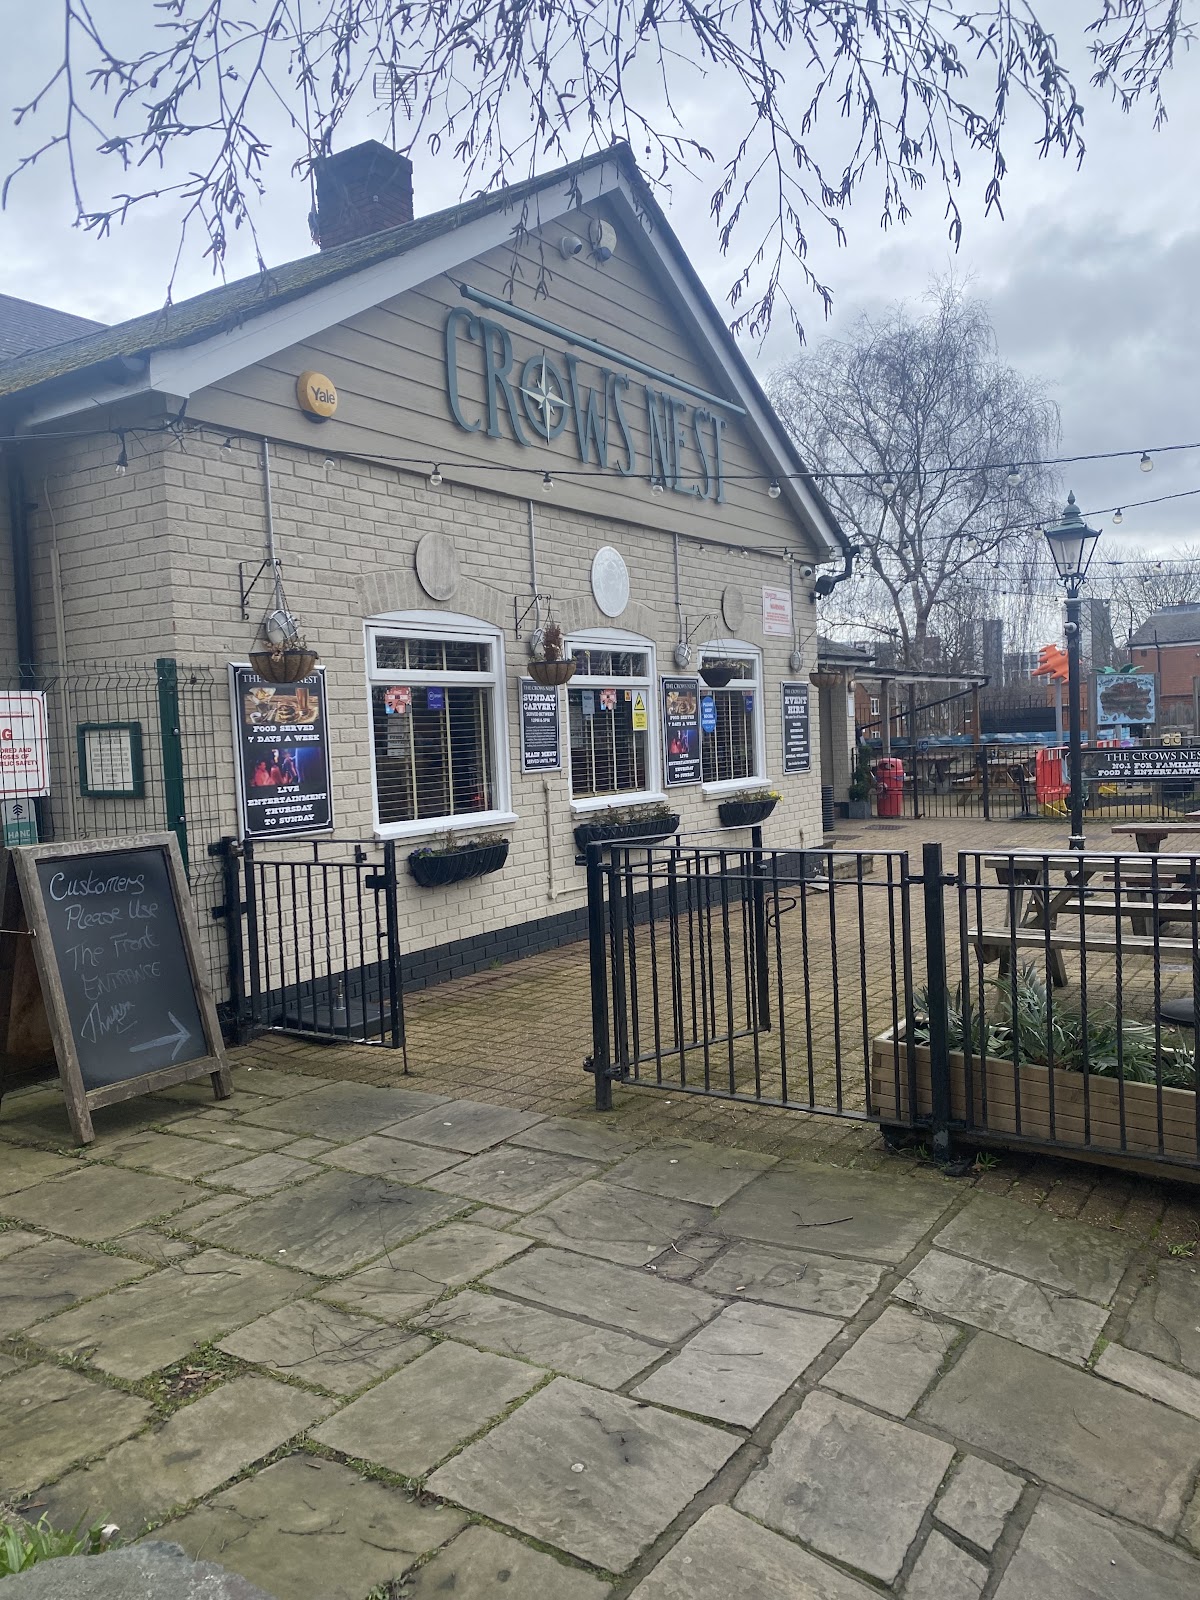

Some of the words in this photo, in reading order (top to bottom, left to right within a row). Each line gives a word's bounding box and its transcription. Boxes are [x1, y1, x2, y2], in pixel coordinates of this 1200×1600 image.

[311, 386, 335, 404] Yale
[446, 306, 636, 477] CROWS
[645, 385, 727, 504] NEST
[242, 675, 261, 683] THE
[785, 696, 807, 704] EVENT
[788, 706, 804, 714] HIRE
[1104, 753, 1129, 761] THE
[1132, 752, 1176, 760] CROWS
[1180, 751, 1200, 760] NES
[277, 785, 300, 793] LIVE
[247, 793, 326, 806] ENTERTAINMENT
[265, 804, 313, 815] THURSDAY
[279, 814, 314, 824] SUNDAY
[50, 870, 145, 901] Customers
[65, 904, 123, 931] Please
[129, 900, 158, 919] Use
[65, 940, 104, 971] The
[110, 926, 160, 957] Front
